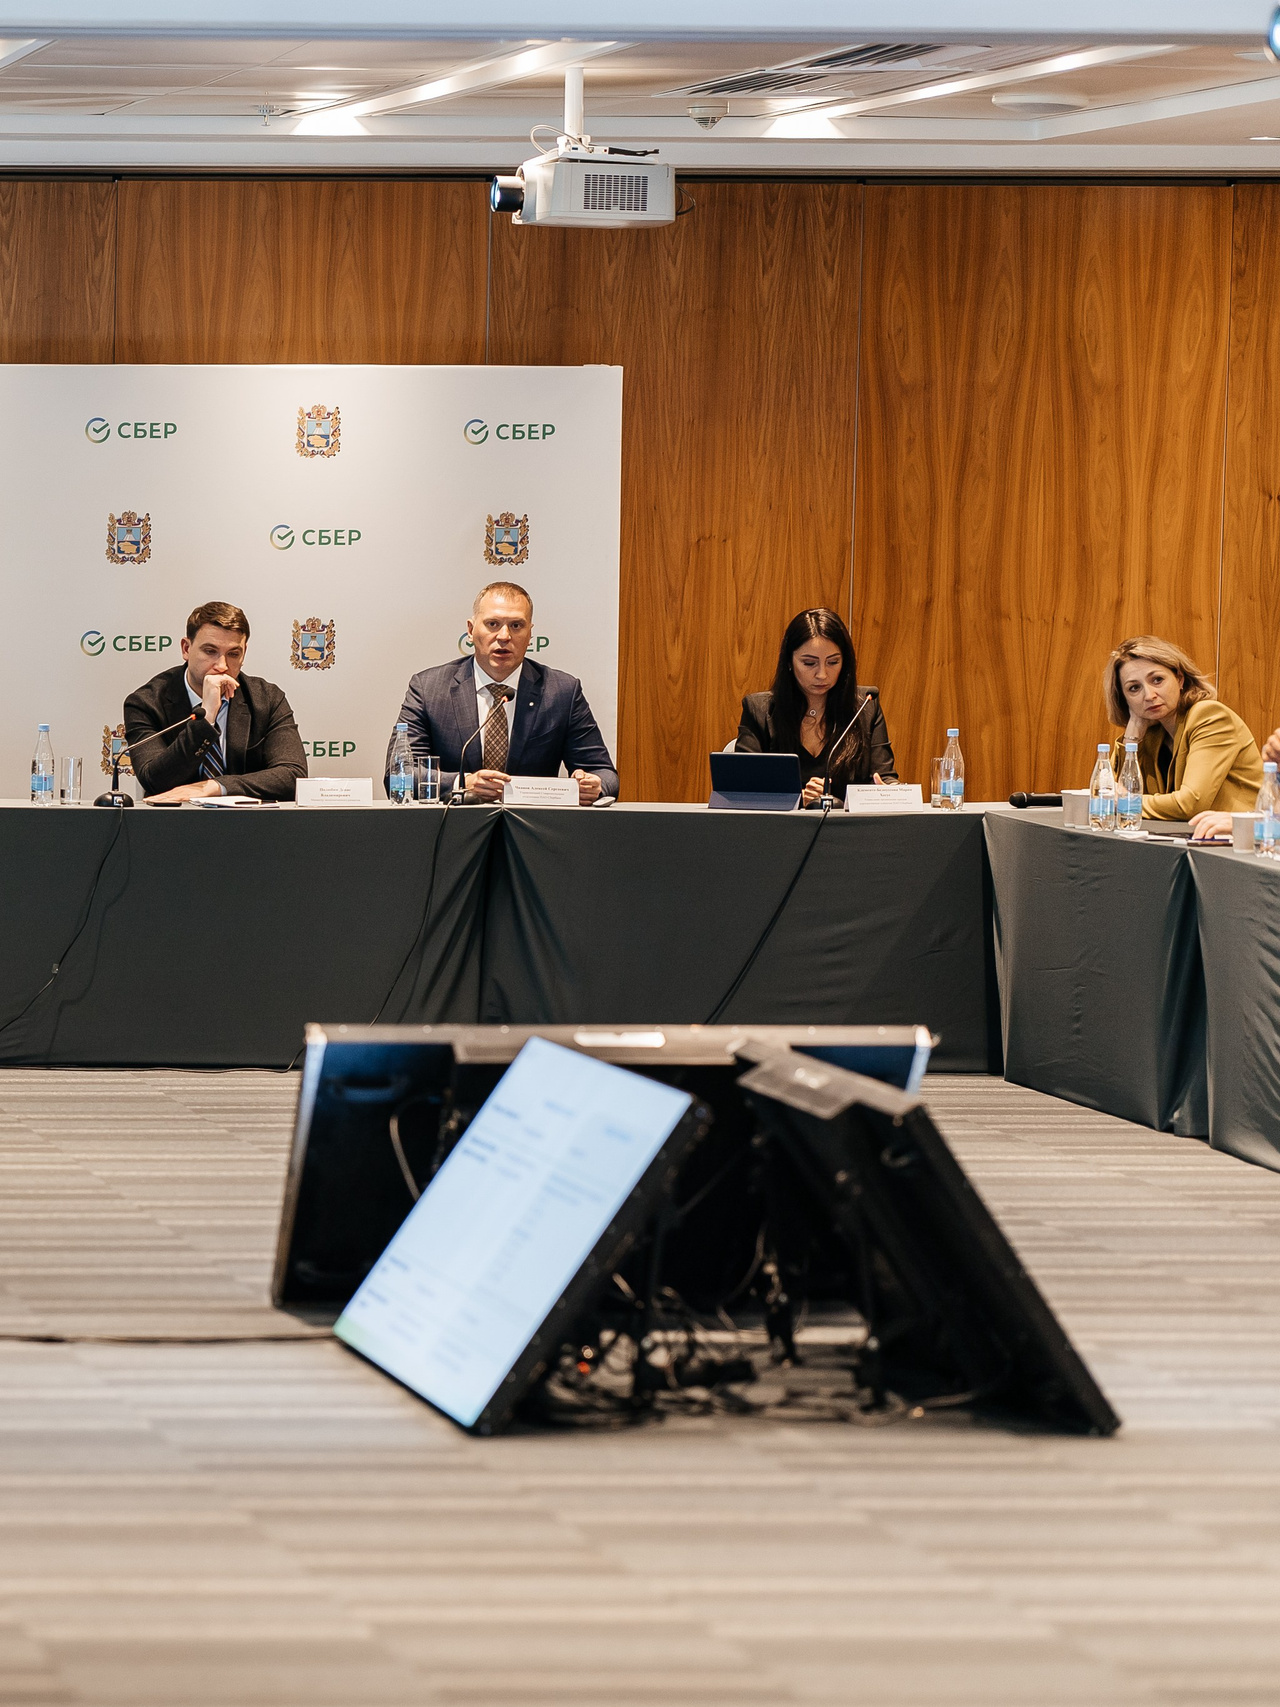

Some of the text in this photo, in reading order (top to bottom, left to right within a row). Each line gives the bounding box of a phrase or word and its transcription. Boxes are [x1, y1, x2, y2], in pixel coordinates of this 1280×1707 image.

[117, 422, 178, 439] СБЕР
[495, 424, 556, 440] СБЕР
[301, 530, 362, 546] СБЕР
[112, 635, 173, 652] СБЕР
